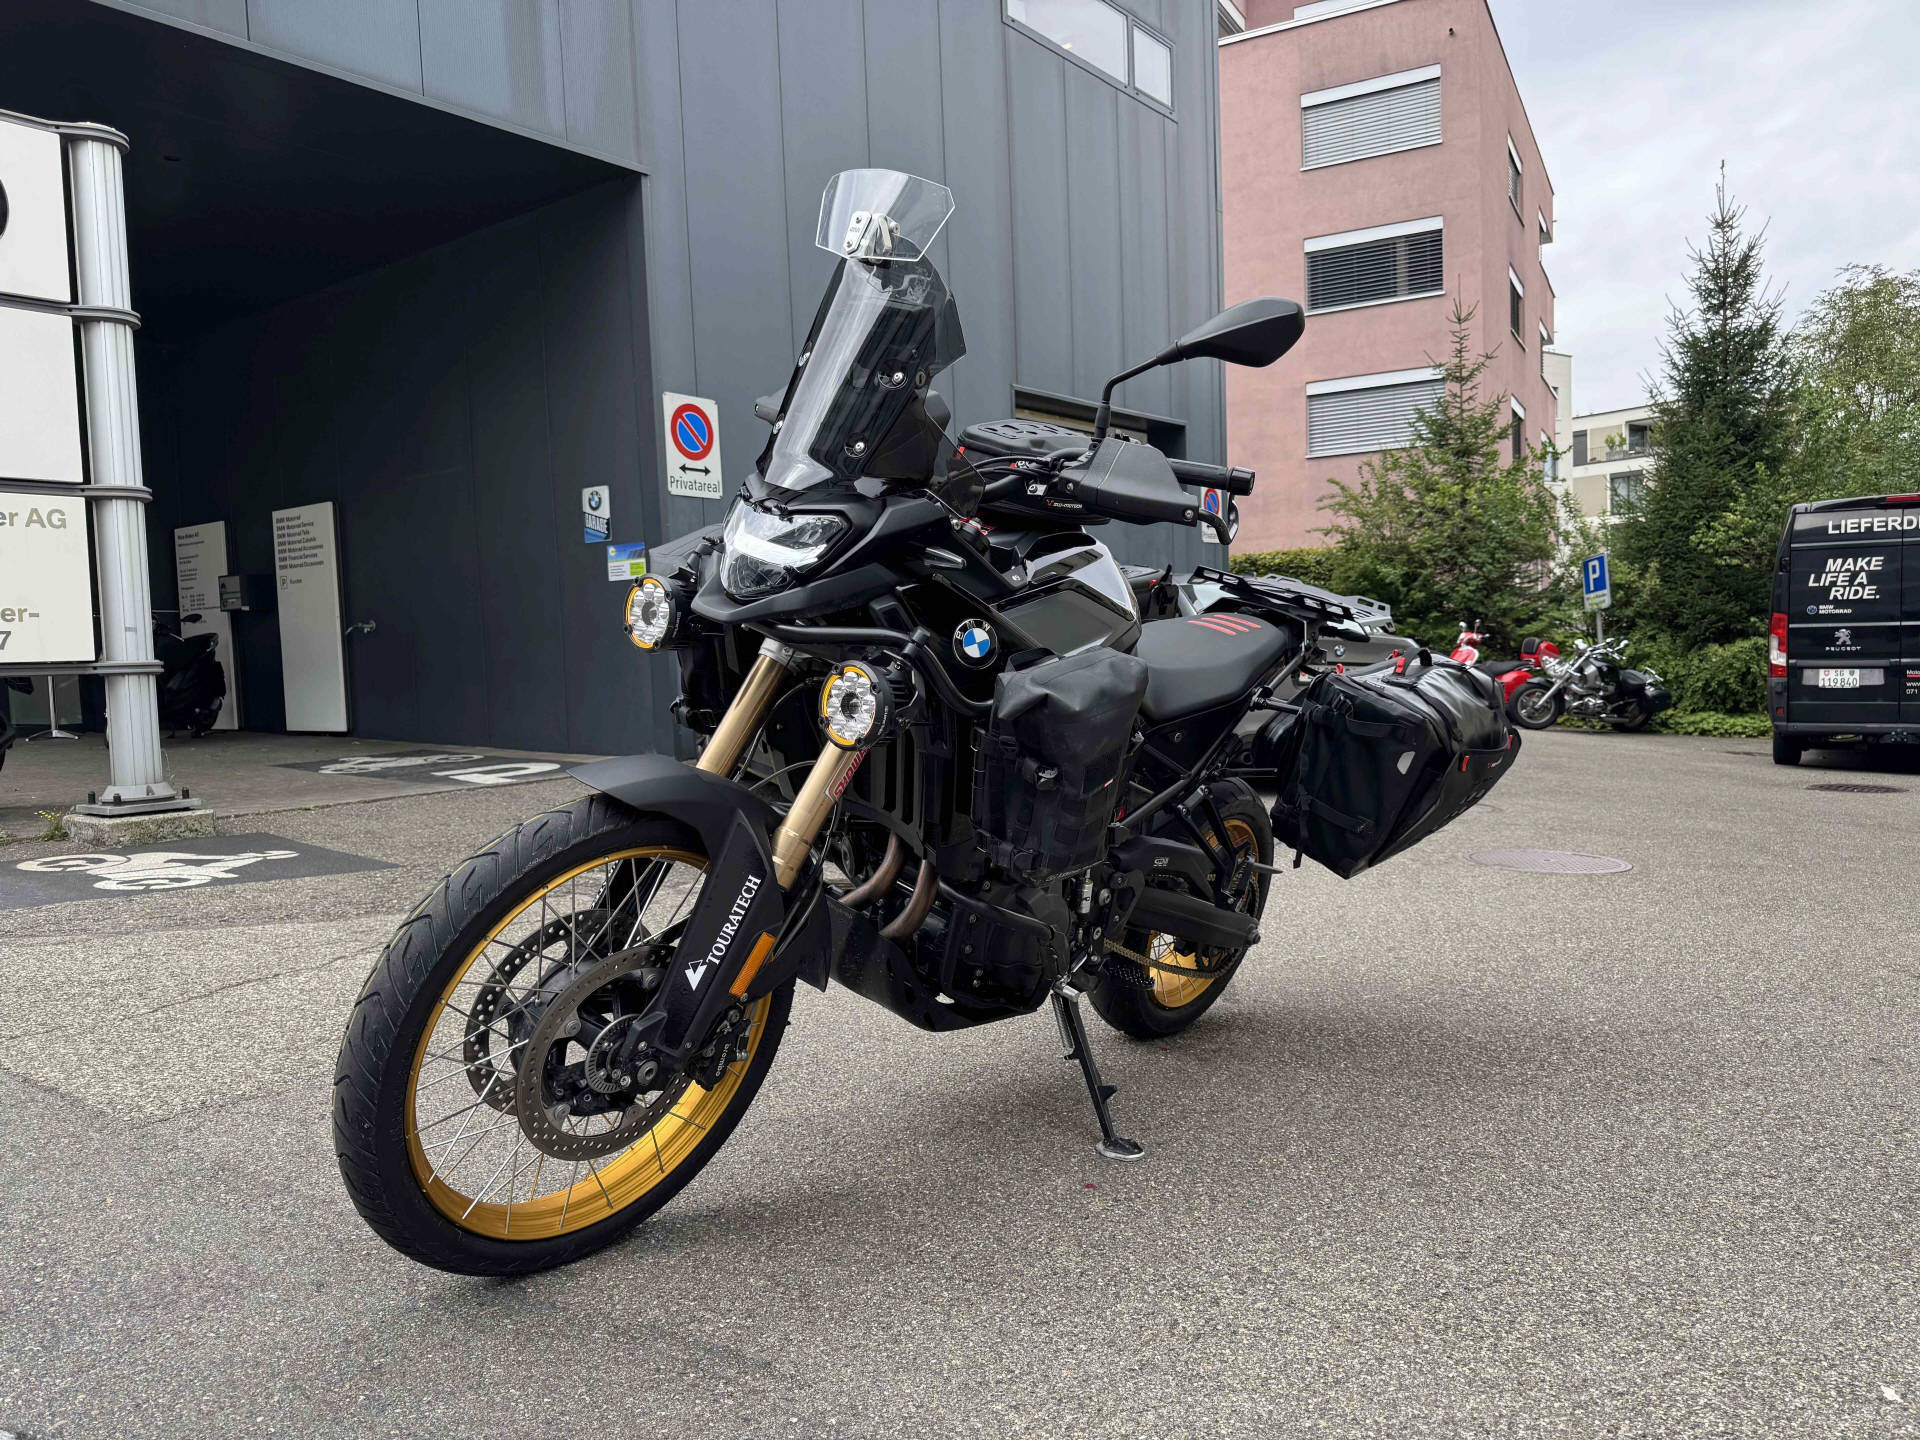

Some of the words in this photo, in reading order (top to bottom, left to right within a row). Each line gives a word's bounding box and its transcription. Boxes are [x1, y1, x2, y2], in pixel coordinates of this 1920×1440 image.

[670, 475, 720, 493] Privatareal
[25, 507, 67, 529] AG
[1825, 556, 1884, 572] MAKE
[1588, 560, 1600, 591] P
[1808, 572, 1851, 587] LIFE
[1853, 571, 1868, 585] A
[1829, 585, 1881, 600] RIDE.
[0, 607, 40, 622] er-
[955, 620, 991, 640] BMW
[705, 875, 761, 965] TOURATECH
